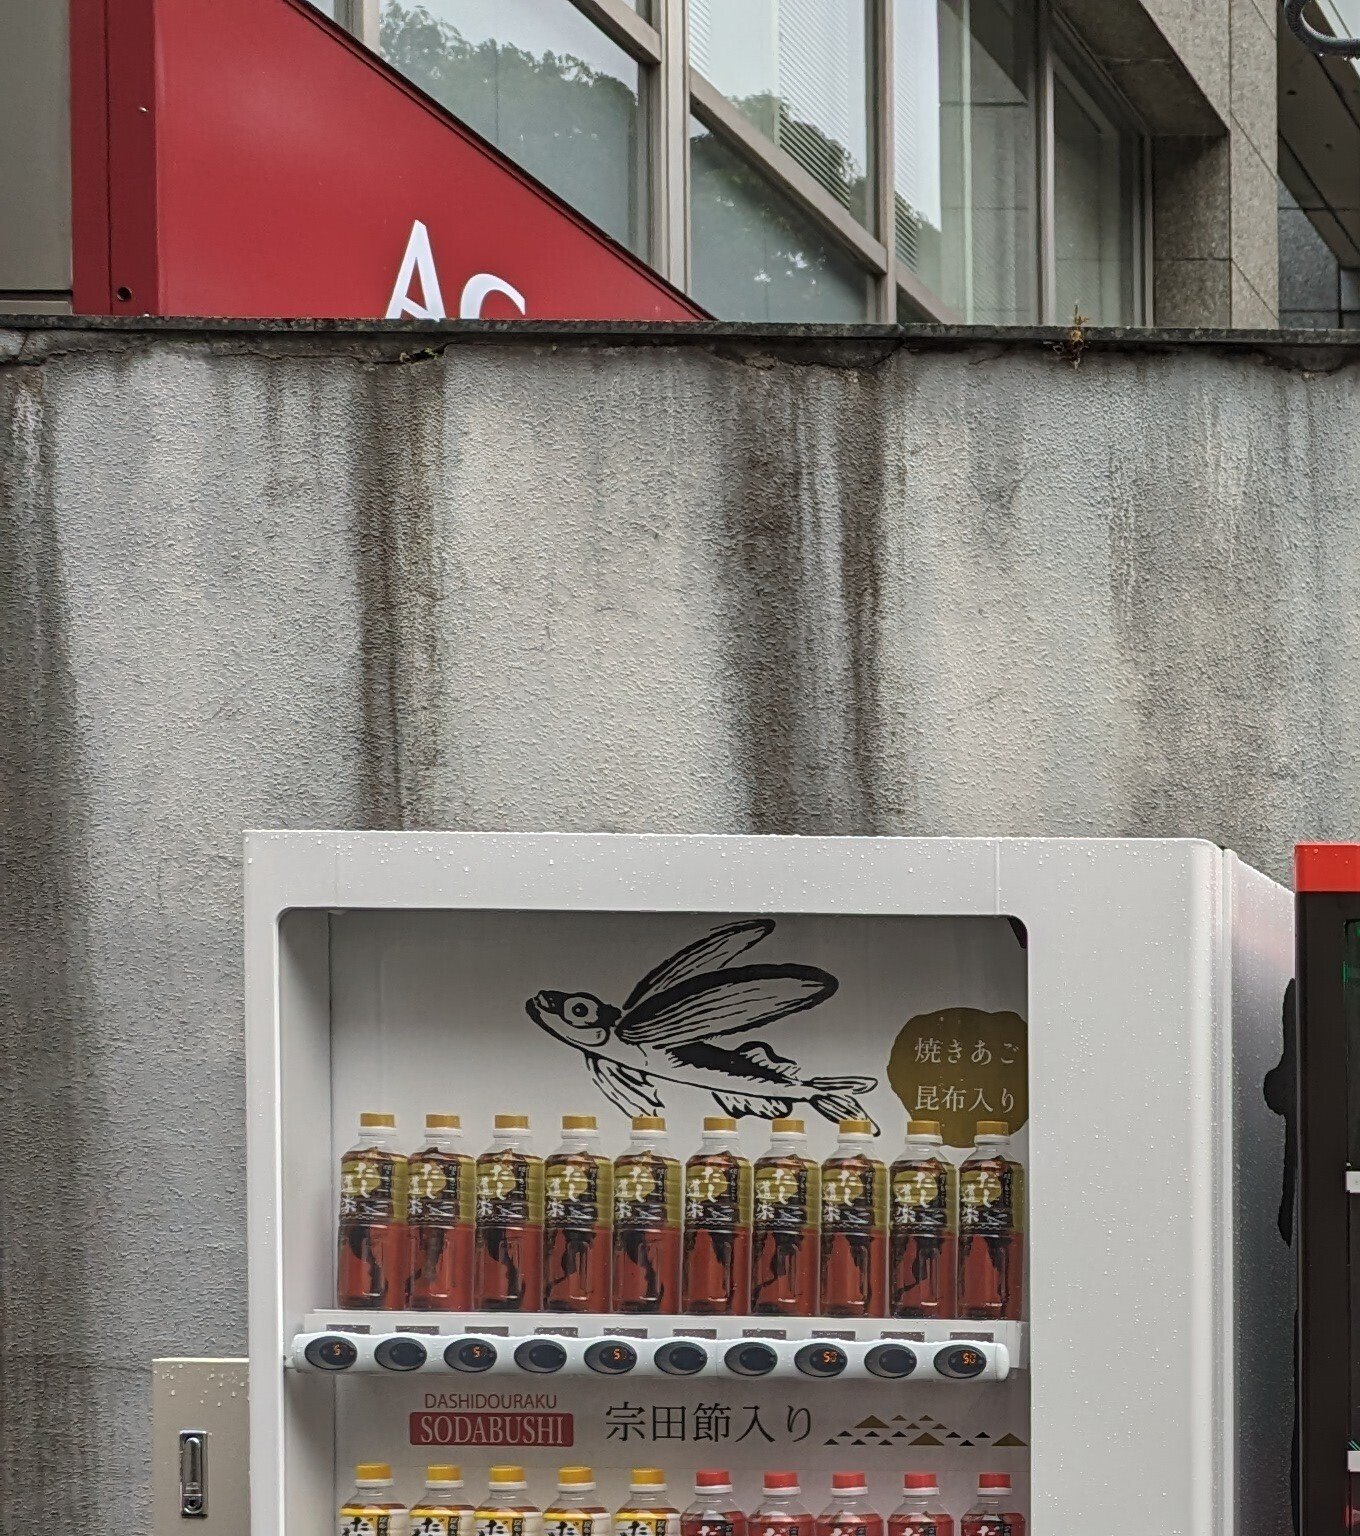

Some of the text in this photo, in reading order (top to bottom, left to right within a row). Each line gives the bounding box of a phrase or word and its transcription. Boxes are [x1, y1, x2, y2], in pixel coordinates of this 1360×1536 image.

[914, 1038, 1020, 1066] 焼きあご
[915, 1086, 1016, 1112] 昆布入り
[425, 1394, 558, 1410] DASHIDOURAKU
[419, 1414, 565, 1446] SODABUSHI
[605, 1401, 812, 1444] 宗田節入り
